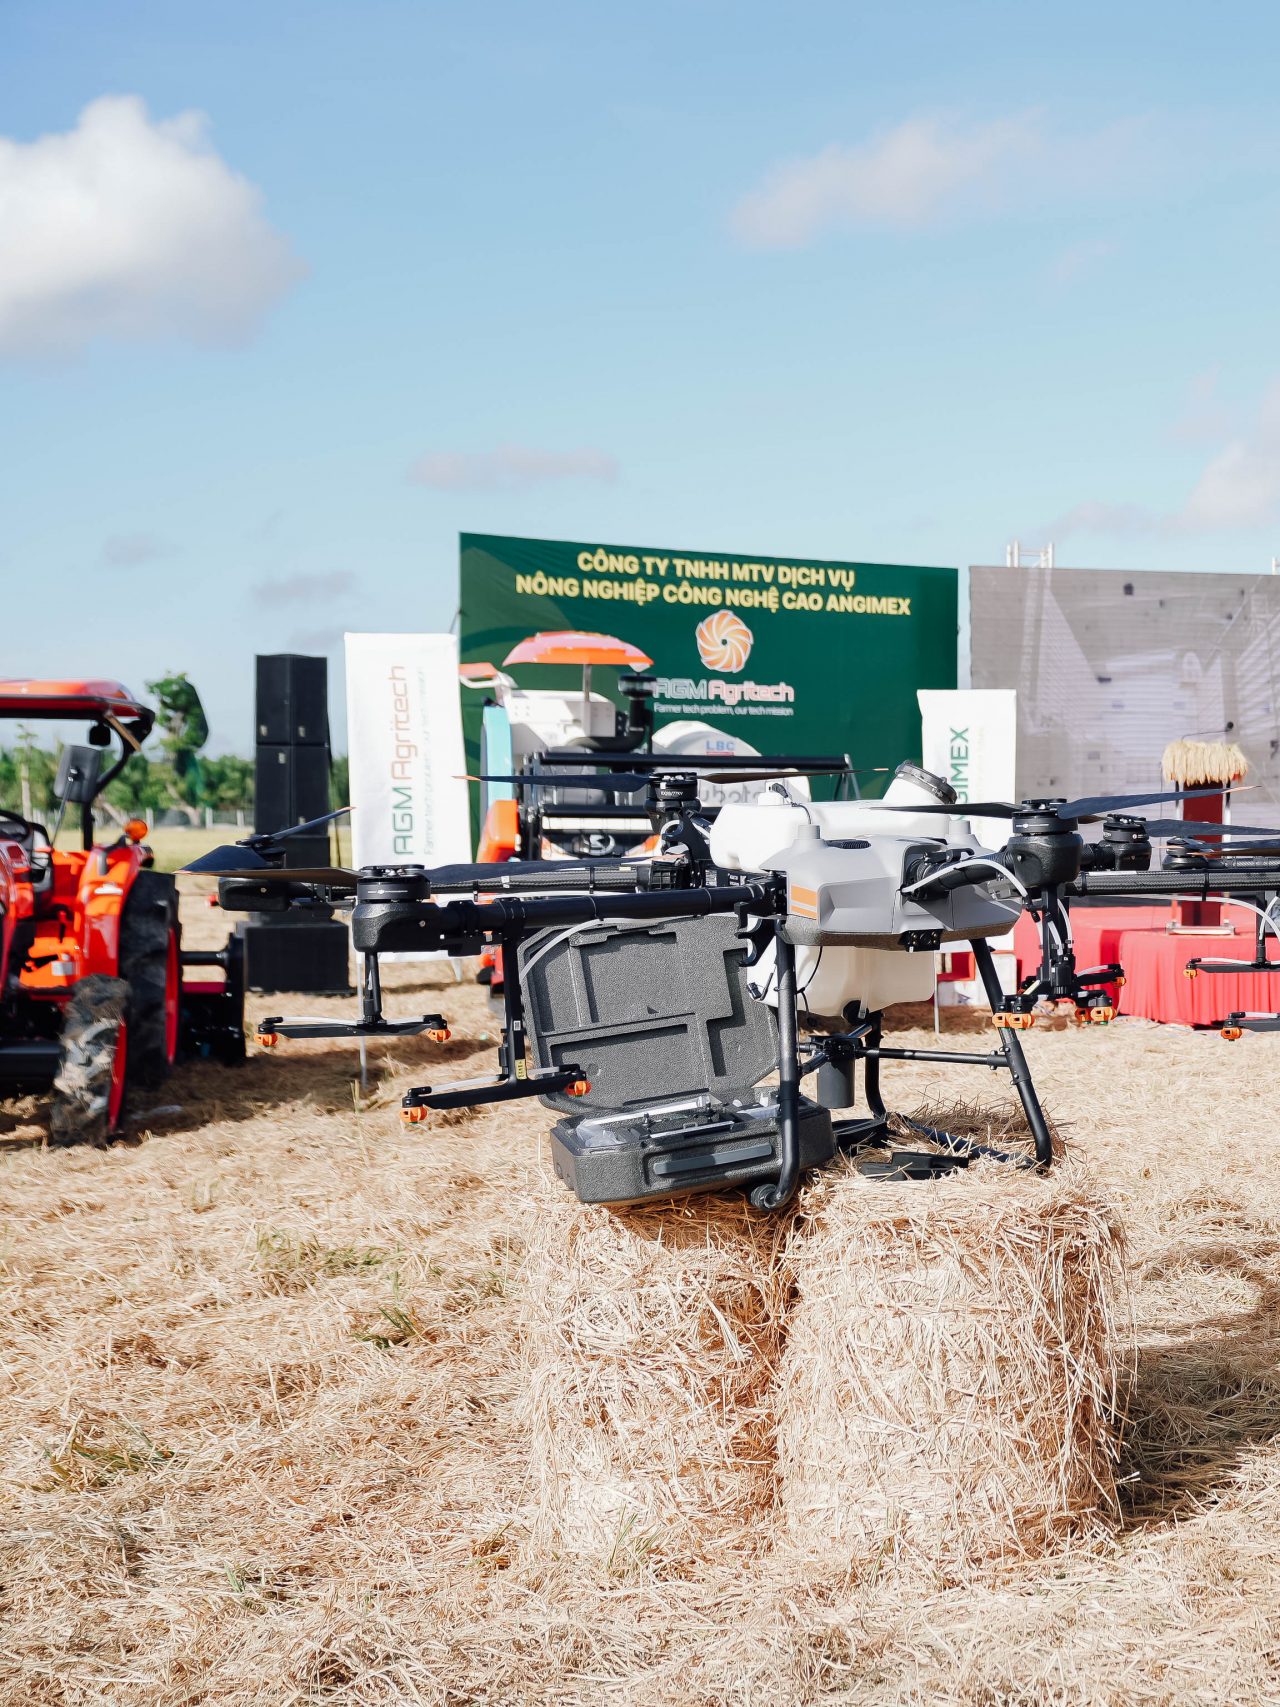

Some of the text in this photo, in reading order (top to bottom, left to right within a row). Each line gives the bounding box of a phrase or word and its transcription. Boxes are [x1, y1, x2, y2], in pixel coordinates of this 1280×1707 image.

[577, 548, 856, 592] CÔNG TY TNHH MTV DỊCH VỤ
[515, 570, 911, 616] NÔNG NGHIỆP CÔNG NGHỆ CAO ANGIMEX
[652, 677, 795, 706] AGM Agritech
[389, 665, 418, 855] AGM Agritech
[706, 740, 735, 751] LBC
[949, 727, 969, 822] GIMEX
